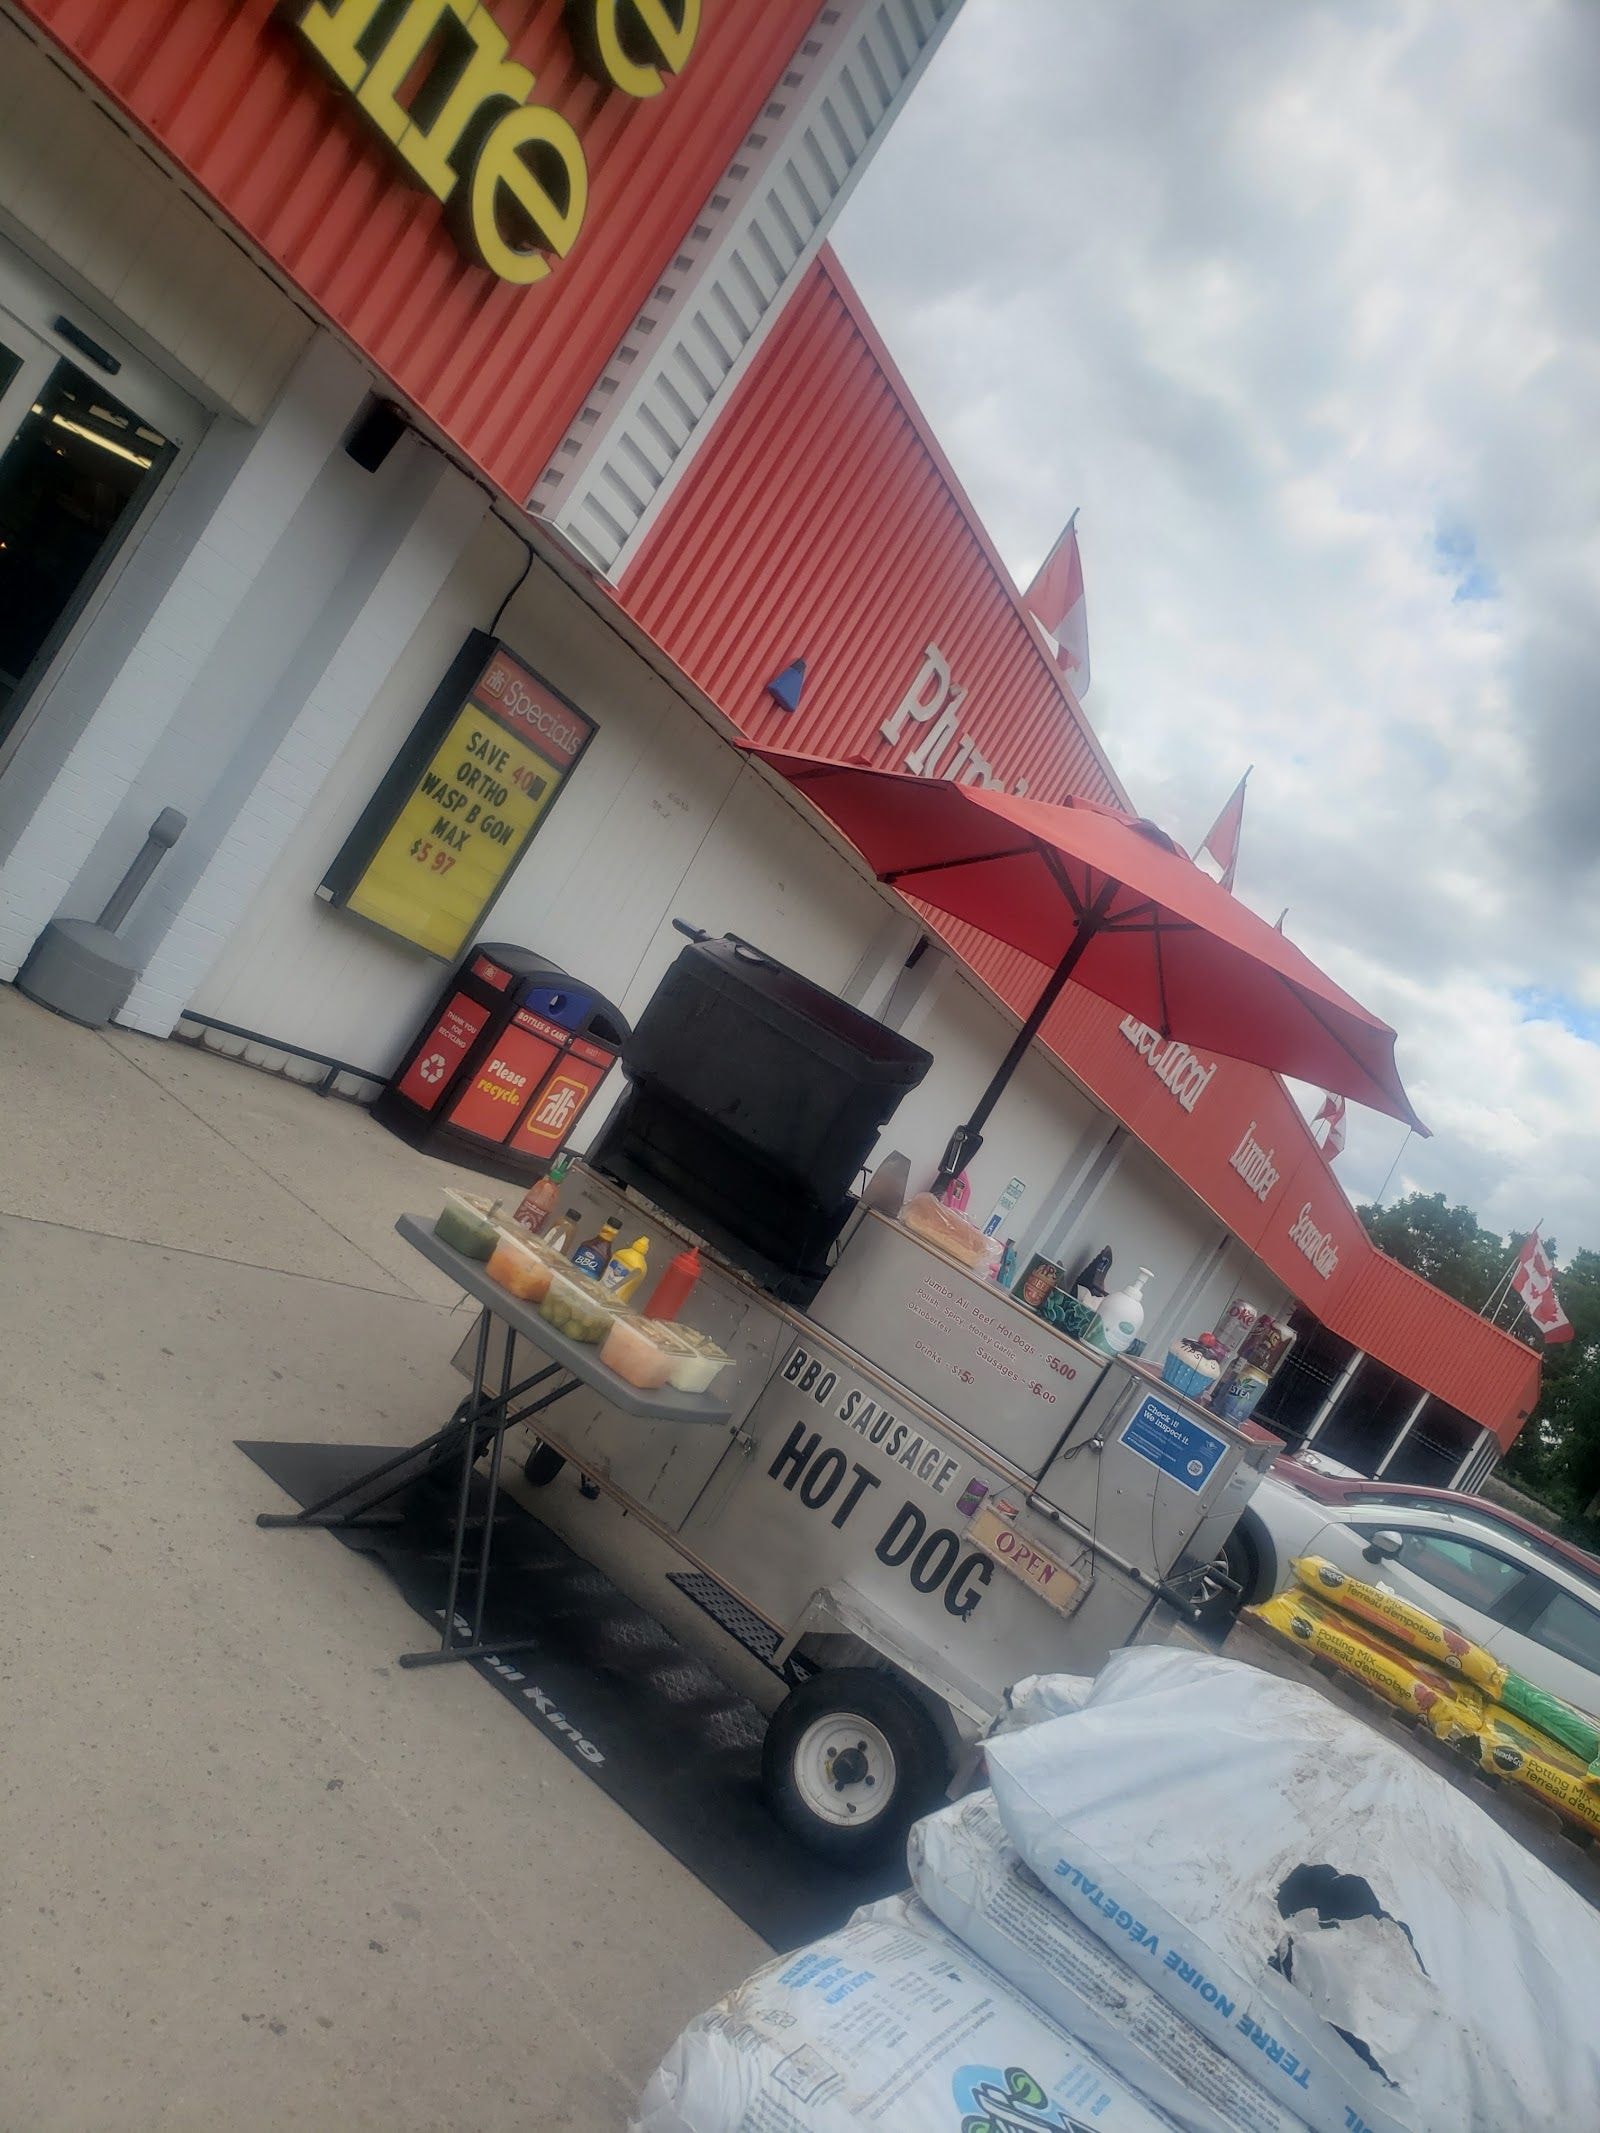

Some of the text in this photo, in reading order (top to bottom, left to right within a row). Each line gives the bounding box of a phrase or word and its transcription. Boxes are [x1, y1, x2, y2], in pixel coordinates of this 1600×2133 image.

[502, 680, 582, 756] Specials
[465, 731, 510, 774] SAVE
[456, 762, 509, 807] ORTHO
[421, 772, 515, 846] WASP B GON
[431, 816, 471, 851] MAX
[438, 1027, 466, 1049] RECYCLING
[447, 1011, 477, 1034] THANK YOU
[451, 1024, 463, 1035] FOR
[517, 1011, 546, 1031] BOTTLES
[550, 1029, 568, 1042] CANS
[477, 1079, 520, 1106] recycle.
[488, 1059, 527, 1087] Please
[1229, 1120, 1280, 1202] Lumber
[574, 1254, 600, 1272] BBQ
[923, 1276, 953, 1299] Jumbo
[955, 1297, 969, 1310] All
[971, 1307, 995, 1325] Beef
[996, 1323, 1012, 1339] Hot
[1013, 1335, 1036, 1355] Dogs
[1045, 1354, 1077, 1381] $5.00
[968, 1324, 992, 1344] Honey
[914, 1340, 942, 1364] Drinks
[976, 1346, 1019, 1381] Sausages
[1028, 1380, 1056, 1404] $6.00
[1230, 1384, 1250, 1400] STEA
[785, 1350, 958, 1494] BBQ SAUSAGE
[1143, 1409, 1190, 1446] We inspect it.
[1147, 1403, 1170, 1422] Check
[767, 1420, 995, 1618] HOT DOG
[995, 1531, 1058, 1585] OPEN
[1347, 1584, 1442, 1643] Terreau d'empotage
[1315, 1637, 1412, 1699] Terreau d'empotage
[1318, 1629, 1376, 1666] Potting Mix
[522, 1685, 605, 1764] King
[1526, 1767, 1600, 1823] Terreau d'emp
[1528, 1759, 1593, 1804] Potting Mix
[1053, 1857, 1162, 1955] VÉGÉTALE
[1162, 1949, 1237, 2018] NOIRE
[1235, 2013, 1312, 2089] TERRE
